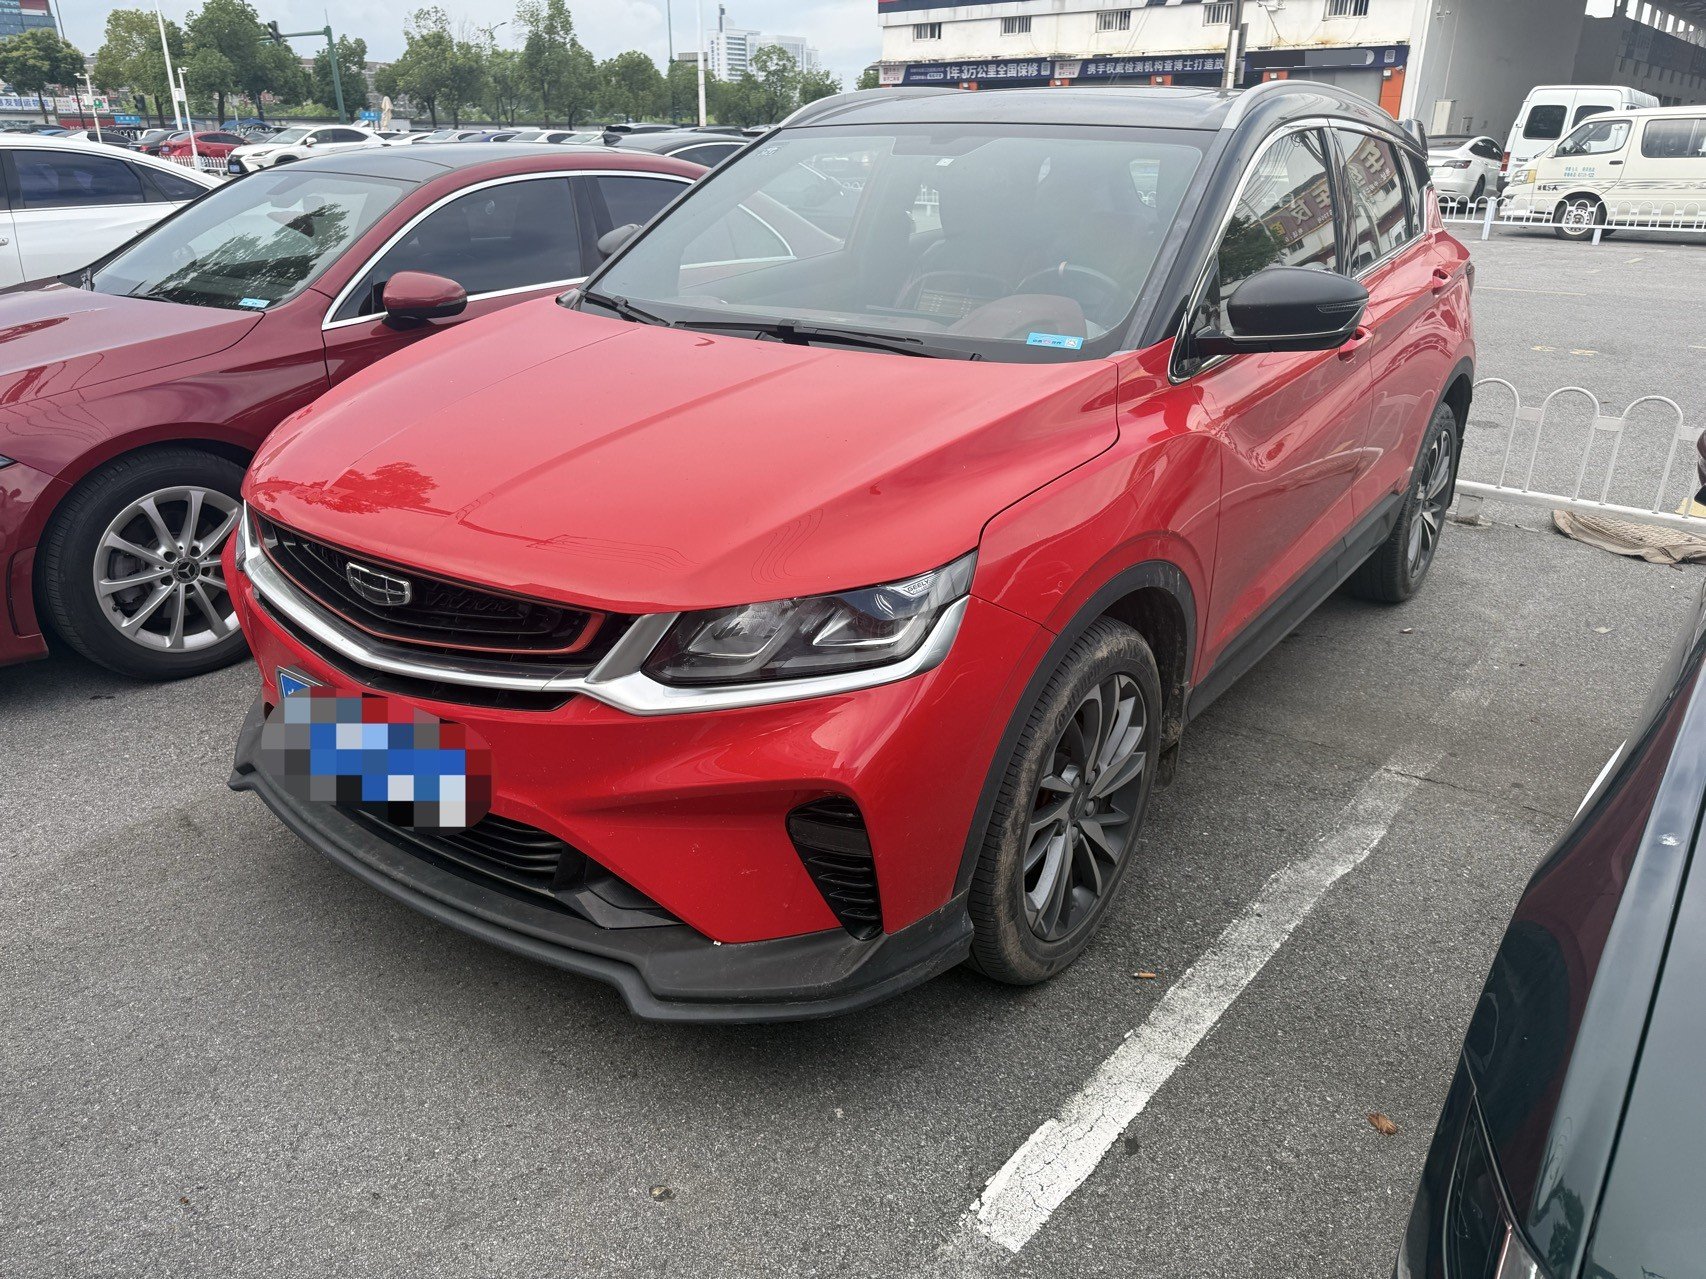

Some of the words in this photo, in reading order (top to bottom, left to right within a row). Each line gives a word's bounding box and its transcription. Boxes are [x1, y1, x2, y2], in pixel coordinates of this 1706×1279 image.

[946, 62, 1039, 79] 1年3万公里全国保修
[907, 579, 930, 592] GEELY
